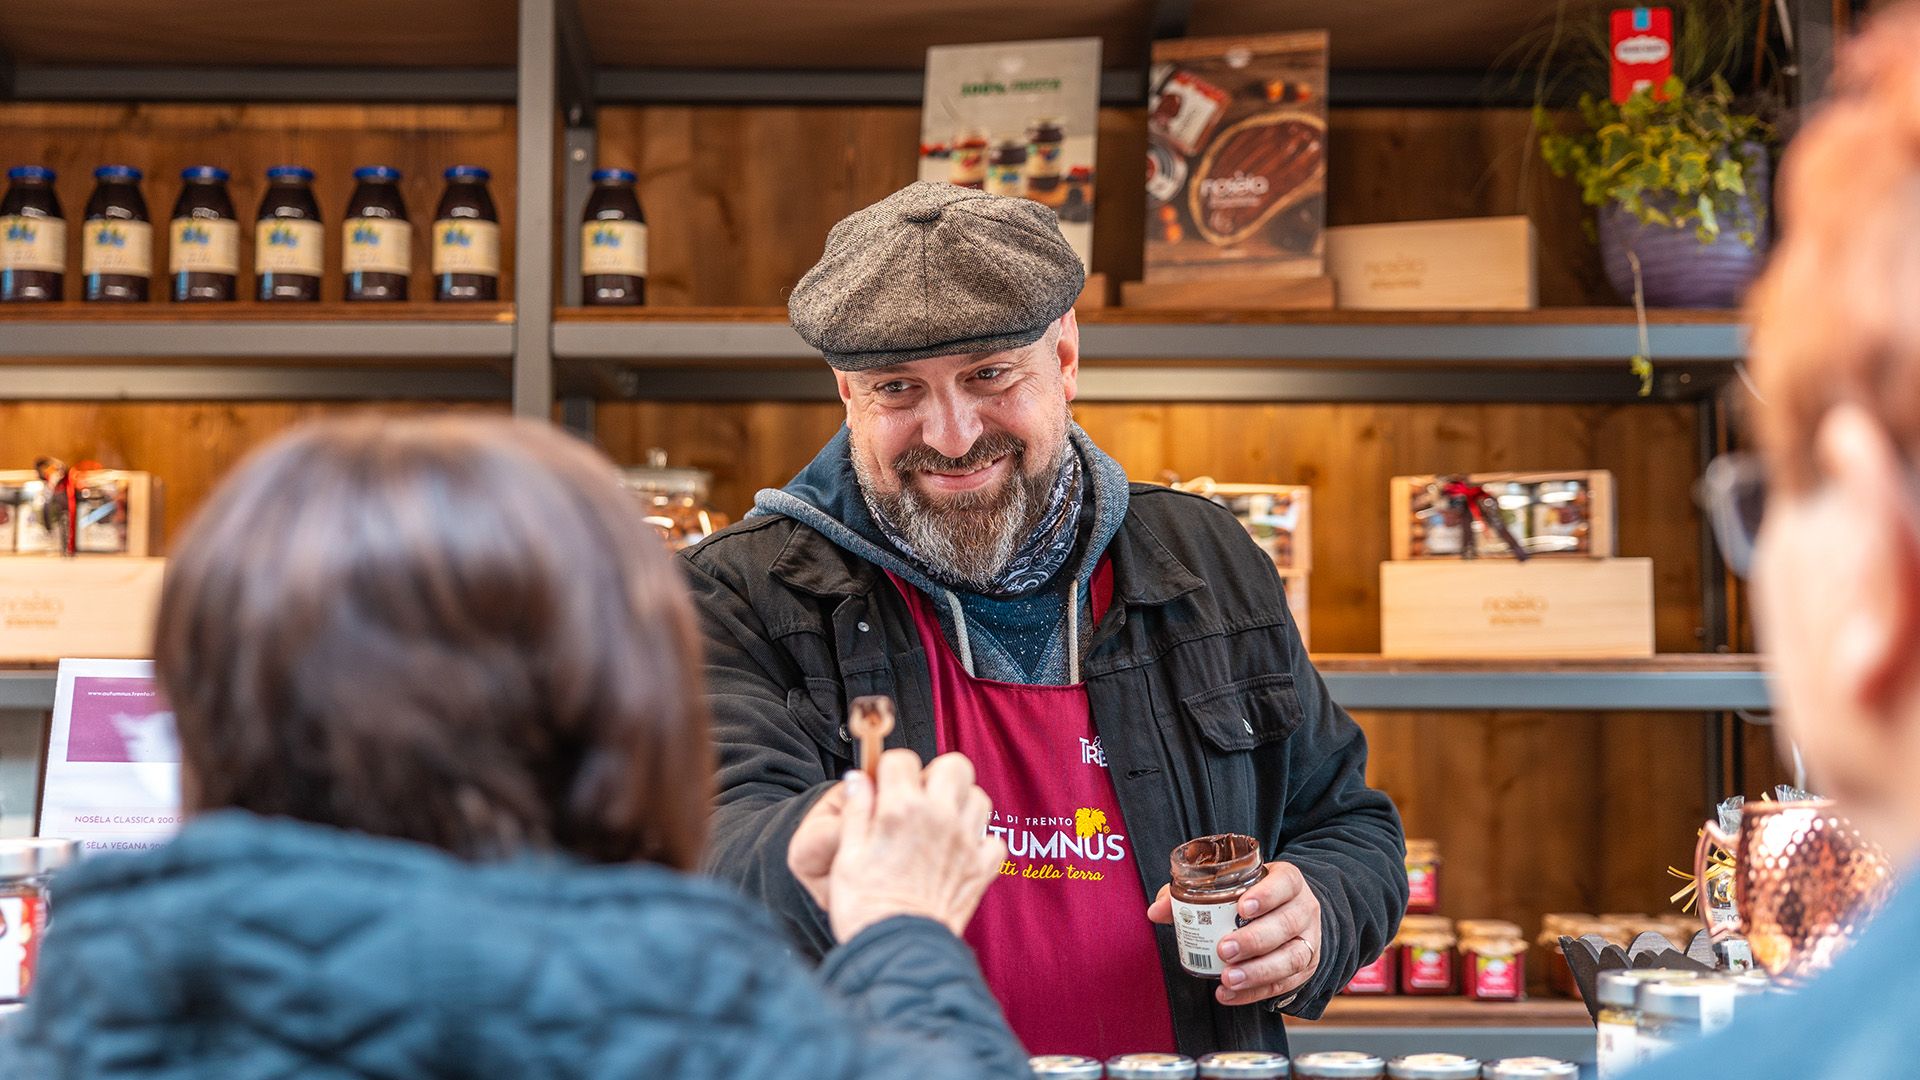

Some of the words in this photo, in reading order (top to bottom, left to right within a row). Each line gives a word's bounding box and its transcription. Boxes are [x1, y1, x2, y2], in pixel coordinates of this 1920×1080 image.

[1079, 735, 1108, 767] TRE
[113, 815, 155, 825] CLASSICA
[157, 816, 174, 825] 200
[1007, 814, 1018, 824] DI
[1025, 816, 1073, 827] TRENTO
[86, 841, 110, 850] SÈLA
[110, 841, 147, 850] VEGANA
[984, 824, 1125, 861] TUMNUS
[998, 860, 1019, 876] tti
[1022, 863, 1064, 880] della
[1066, 864, 1104, 881] terra
